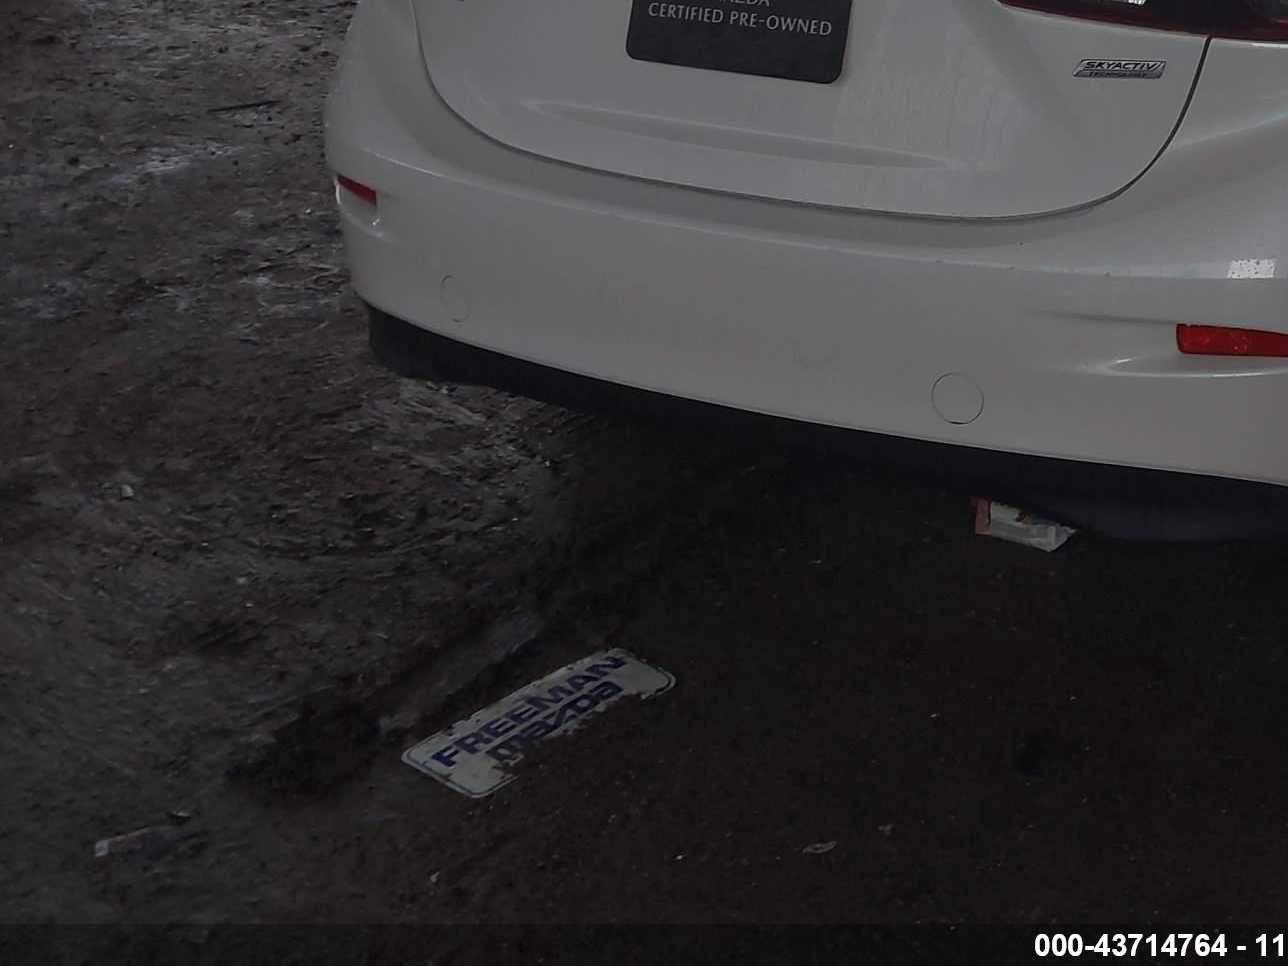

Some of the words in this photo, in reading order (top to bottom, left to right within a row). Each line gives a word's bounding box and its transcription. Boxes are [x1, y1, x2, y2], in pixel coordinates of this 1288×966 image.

[648, 2, 723, 24] CERTIFIED
[729, 11, 833, 36] PRE-OWNED
[1085, 61, 1158, 71] SKYACTIV
[430, 655, 625, 768] FREEMAN
